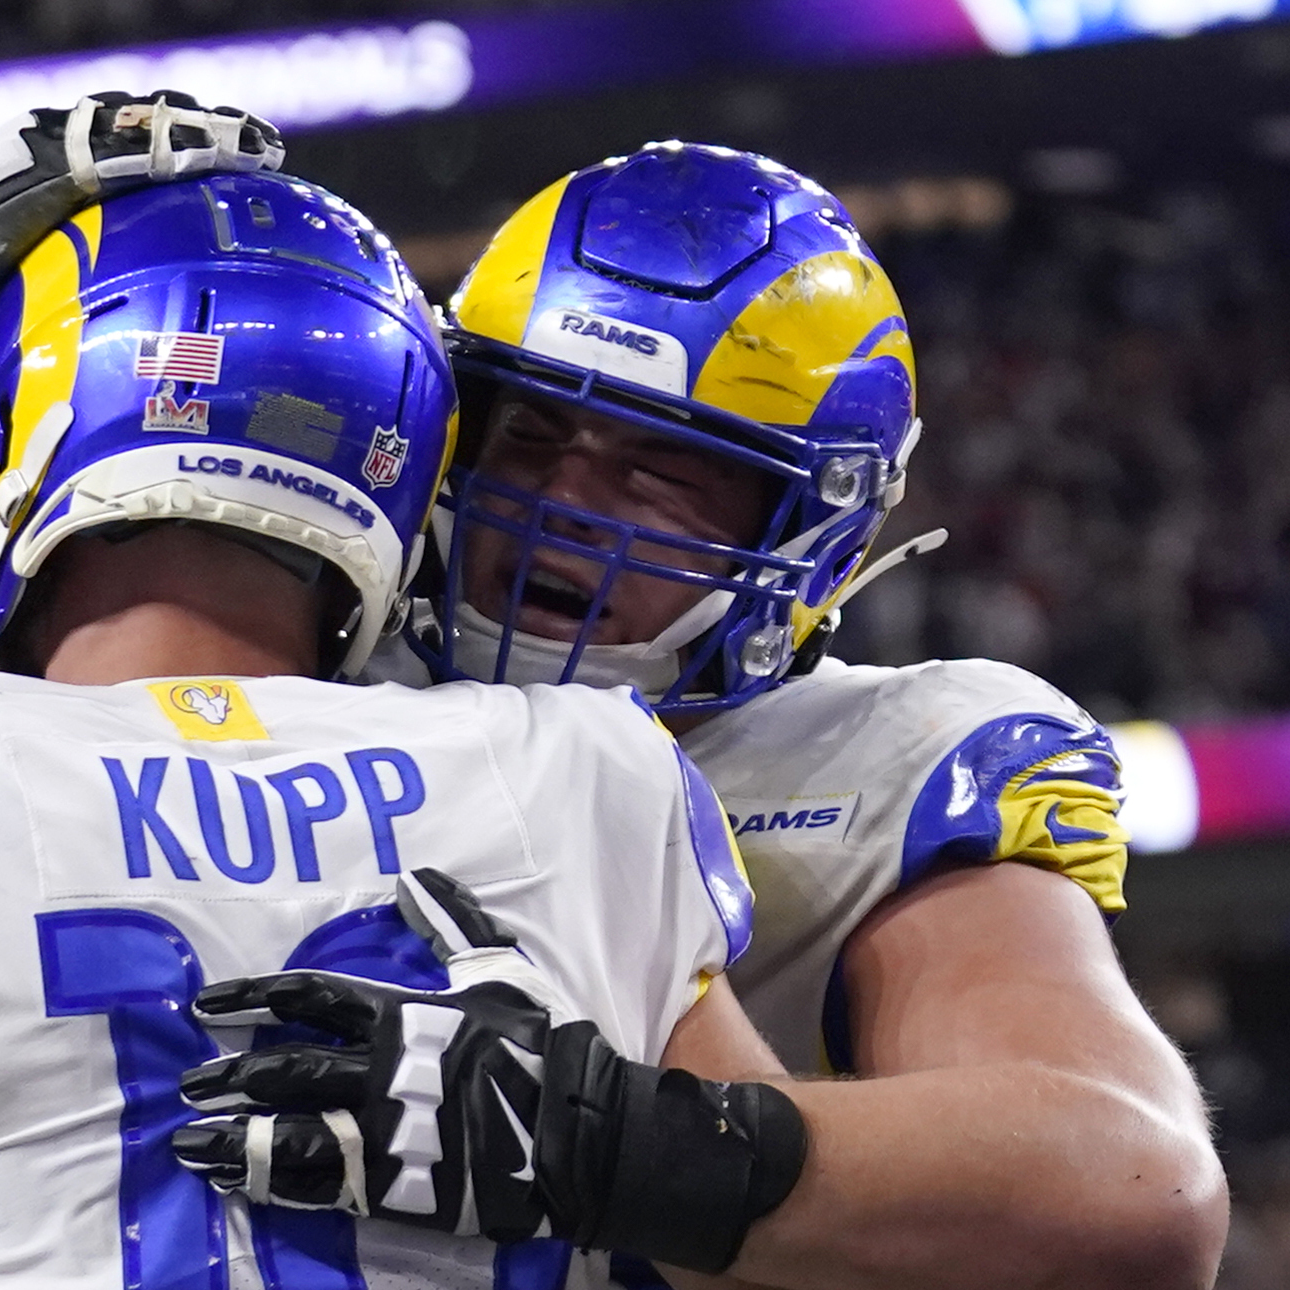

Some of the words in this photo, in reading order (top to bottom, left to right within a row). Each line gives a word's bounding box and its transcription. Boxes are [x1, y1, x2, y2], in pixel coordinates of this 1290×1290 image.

[560, 314, 661, 356] RAMS
[177, 455, 243, 477] LOS
[248, 463, 377, 529] ANGELES
[368, 451, 397, 481] NFL
[101, 746, 426, 885] KUPP
